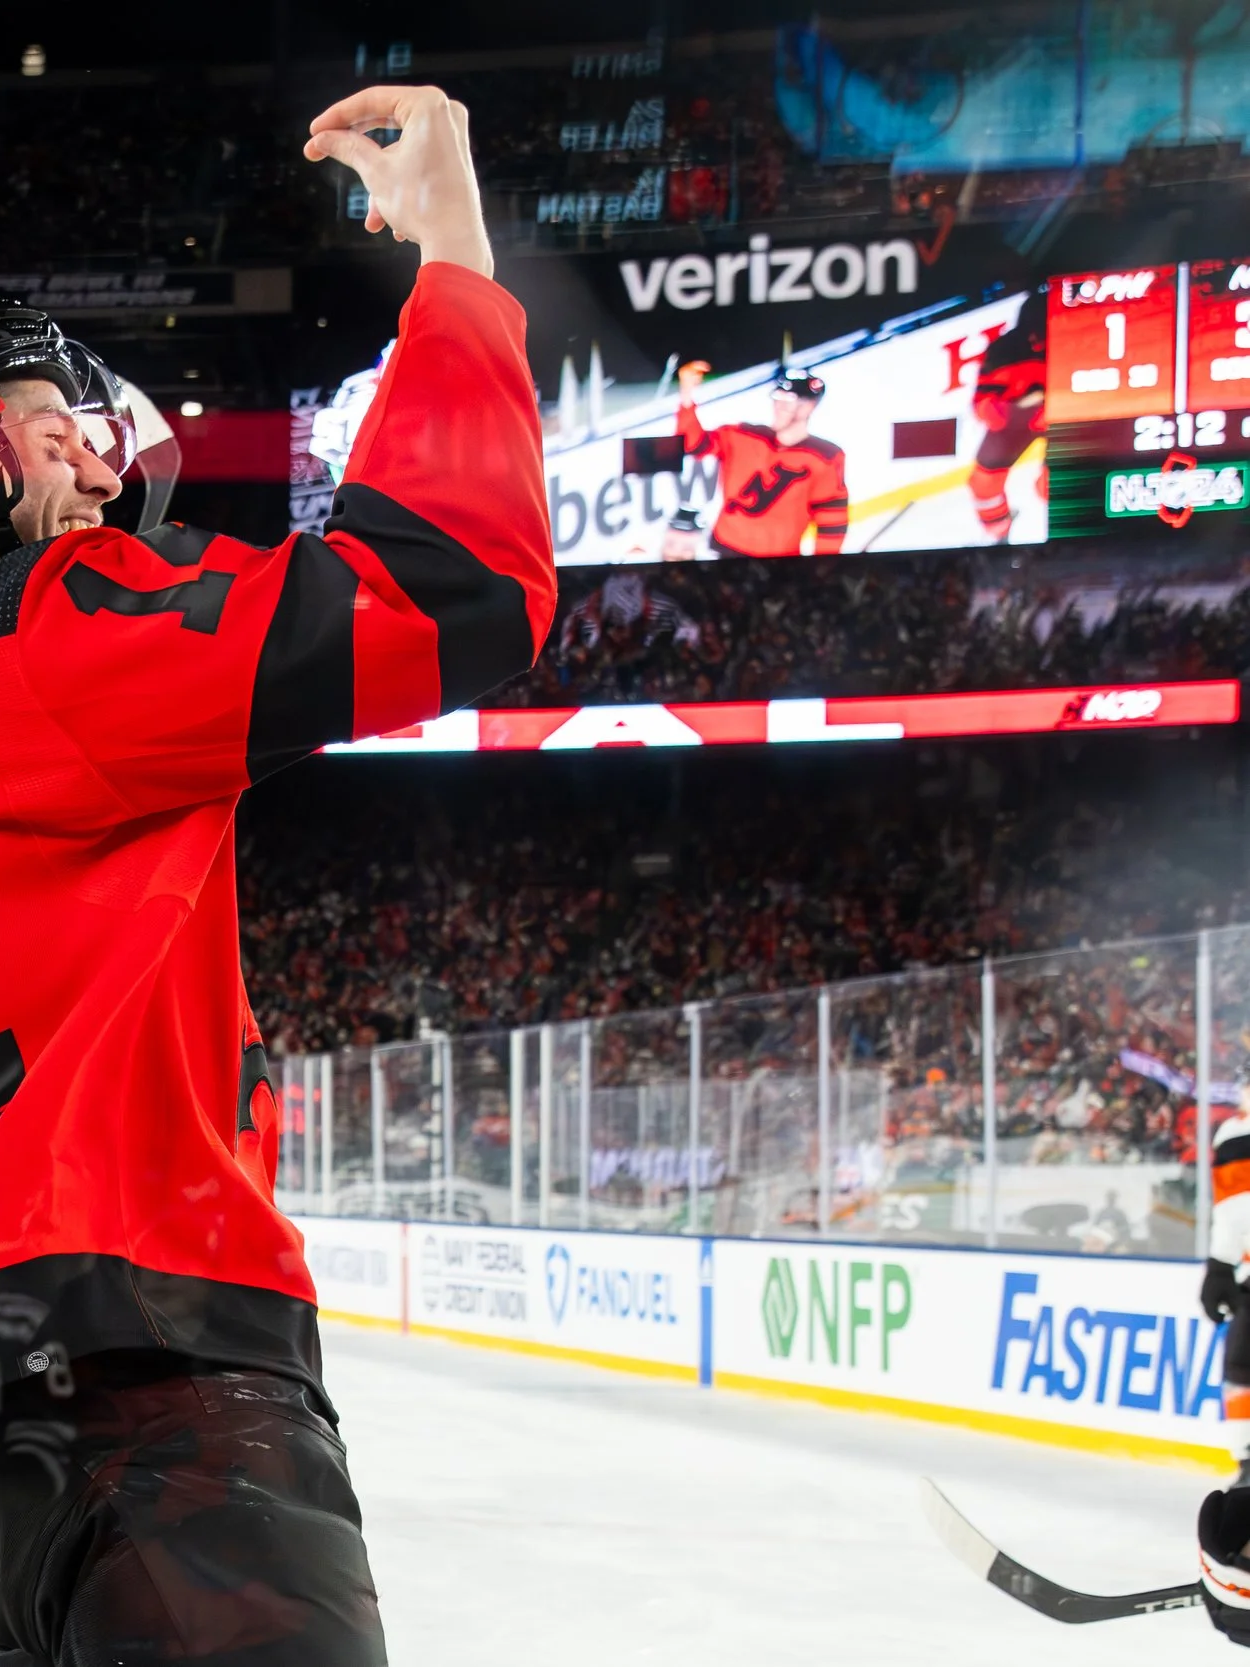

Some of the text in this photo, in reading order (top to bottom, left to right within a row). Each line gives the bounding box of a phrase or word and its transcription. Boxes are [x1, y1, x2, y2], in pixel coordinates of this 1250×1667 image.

[620, 233, 918, 311] verizon
[1105, 313, 1126, 360] 1
[1134, 410, 1227, 452] 2:12
[576, 1266, 678, 1325] FANDUEL
[809, 1259, 913, 1372] NFP
[989, 1271, 1225, 1421] FASTENA
